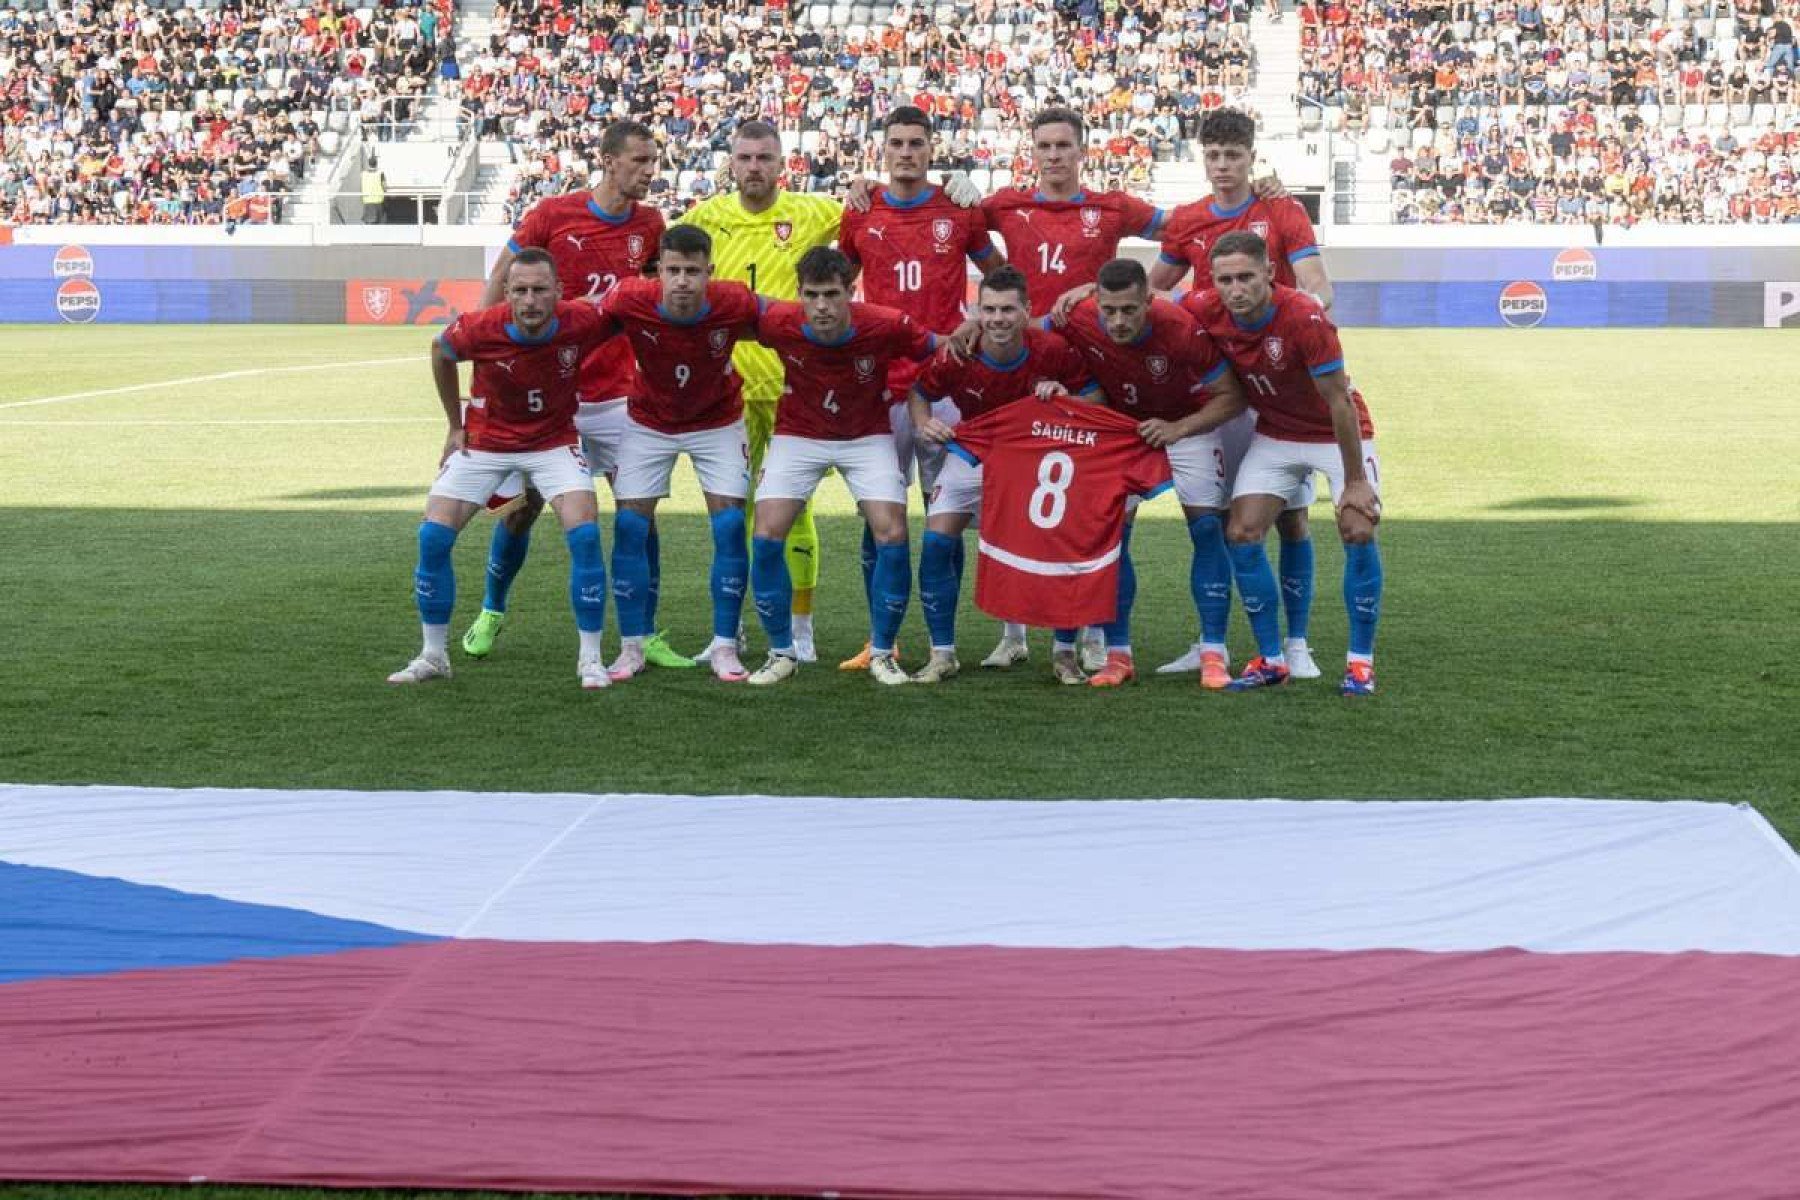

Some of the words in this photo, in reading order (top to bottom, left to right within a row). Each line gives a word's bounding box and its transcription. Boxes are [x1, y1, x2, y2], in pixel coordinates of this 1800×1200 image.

[56, 262, 91, 271] PEPSI
[1037, 242, 1066, 275] 14
[1555, 264, 1594, 276] PEPSI
[587, 273, 617, 297] 22
[746, 263, 757, 292] 1
[893, 260, 922, 292] 10
[59, 296, 98, 307] PEPSI
[1502, 299, 1544, 310] PEPSI
[675, 364, 690, 388] 9
[1247, 374, 1277, 396] 11
[527, 389, 544, 412] 5
[822, 389, 840, 414] 4
[1122, 383, 1138, 405] 3
[1031, 420, 1098, 447] SADÍLEK
[1028, 450, 1074, 530] 8
